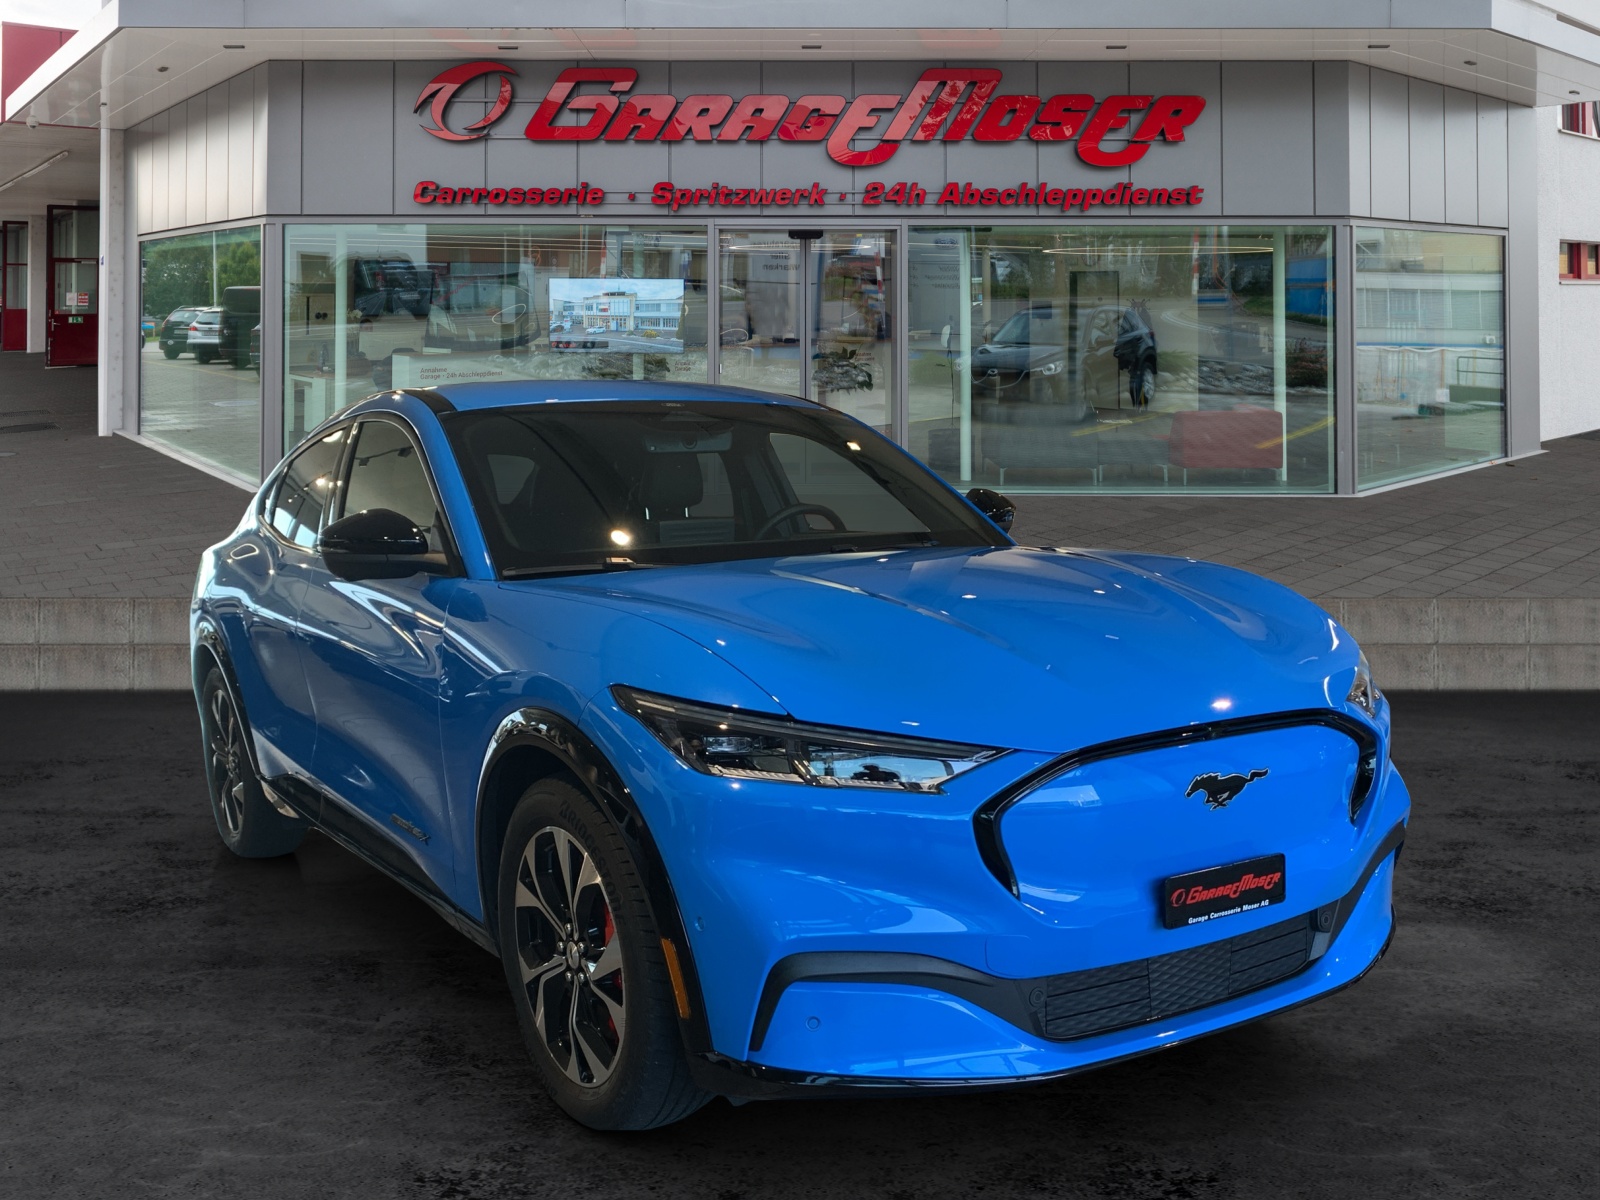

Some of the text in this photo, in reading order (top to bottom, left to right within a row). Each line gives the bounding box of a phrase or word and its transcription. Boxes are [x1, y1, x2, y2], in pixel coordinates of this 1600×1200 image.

[413, 180, 1204, 211] Carrosserie Spritzwerk 24h Abschleppdienst
[458, 370, 503, 379] Abschleppdienst
[1188, 899, 1269, 924] Garage Carrosserie Moser AG
